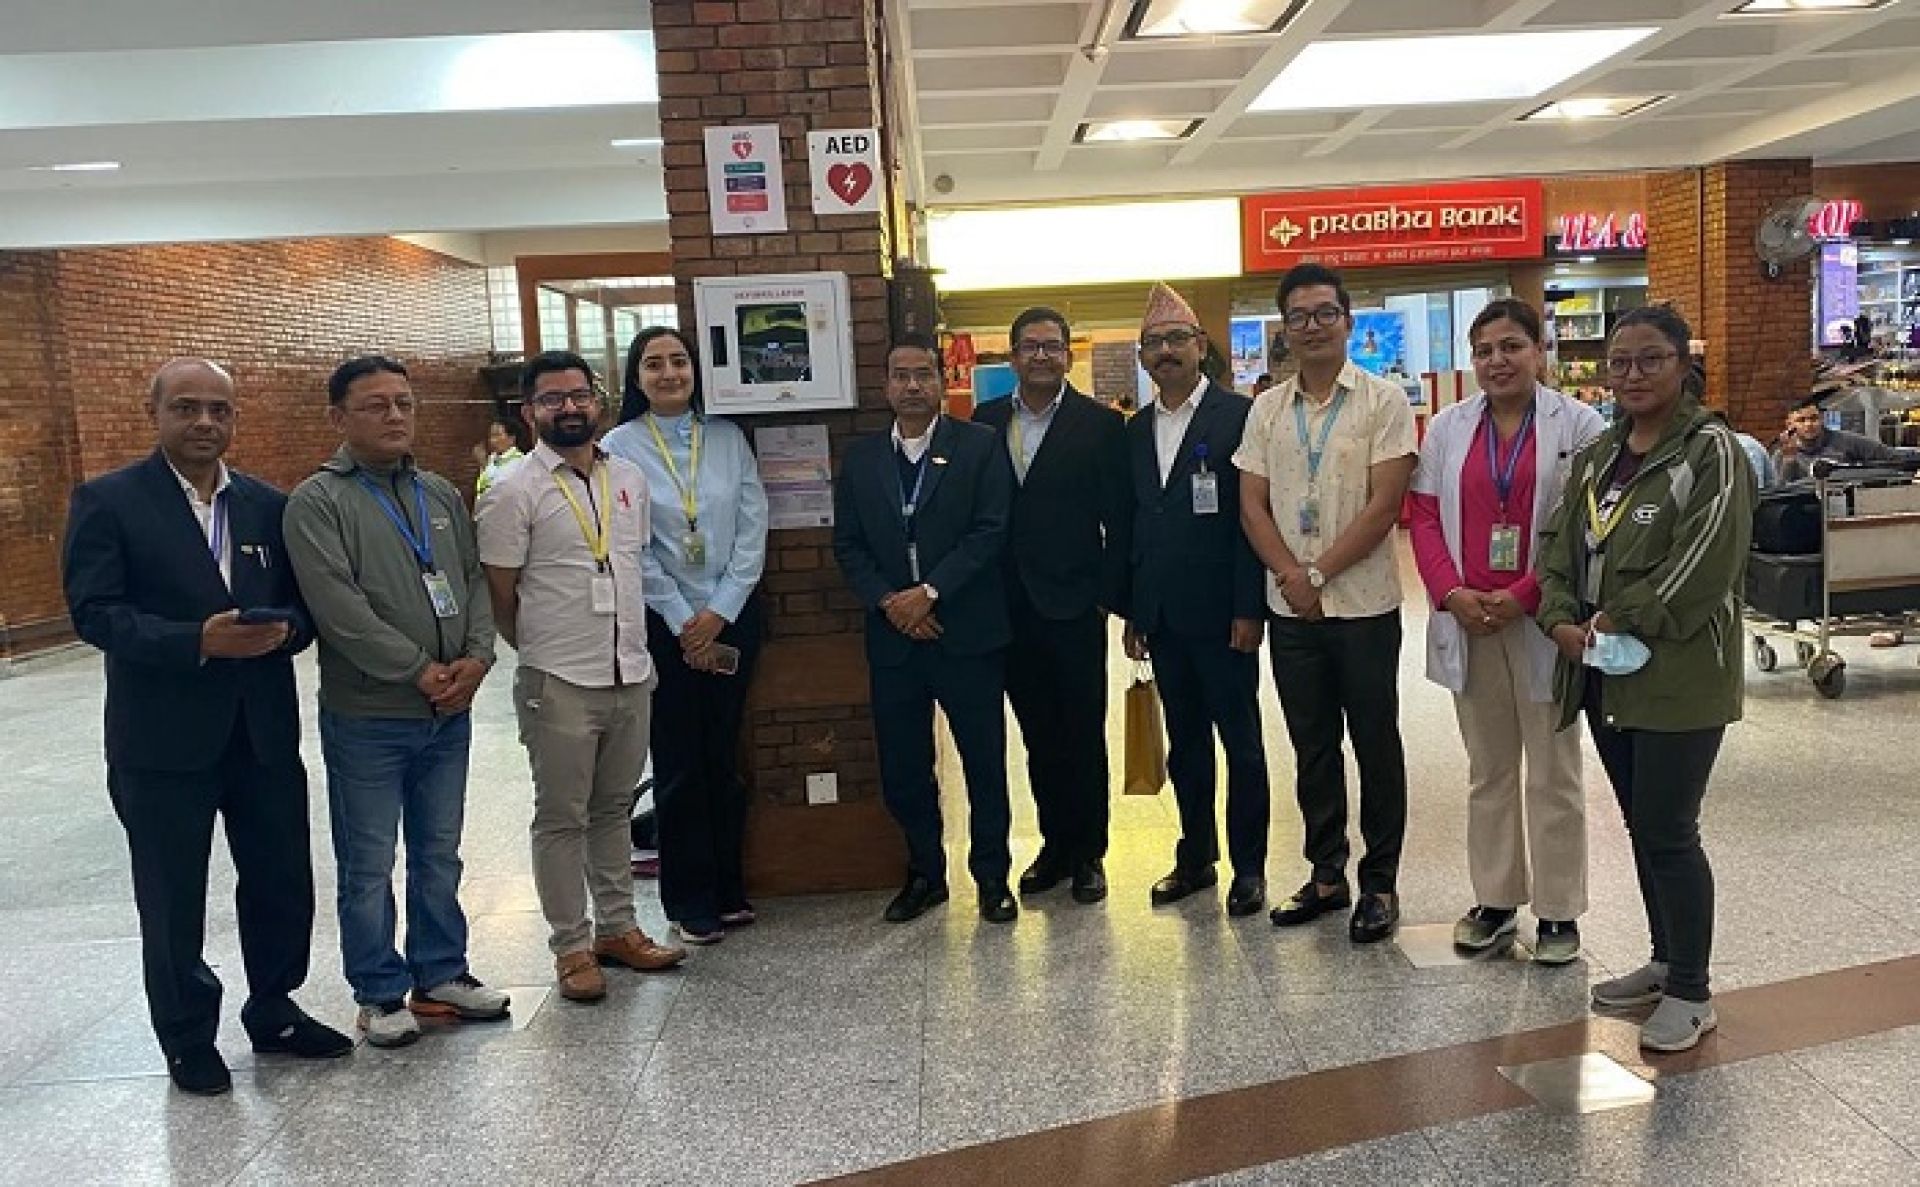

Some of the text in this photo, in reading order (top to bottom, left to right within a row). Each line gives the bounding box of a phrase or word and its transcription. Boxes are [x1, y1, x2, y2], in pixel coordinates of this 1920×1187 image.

[825, 136, 869, 154] AED
[1556, 211, 1647, 250] TEA &
